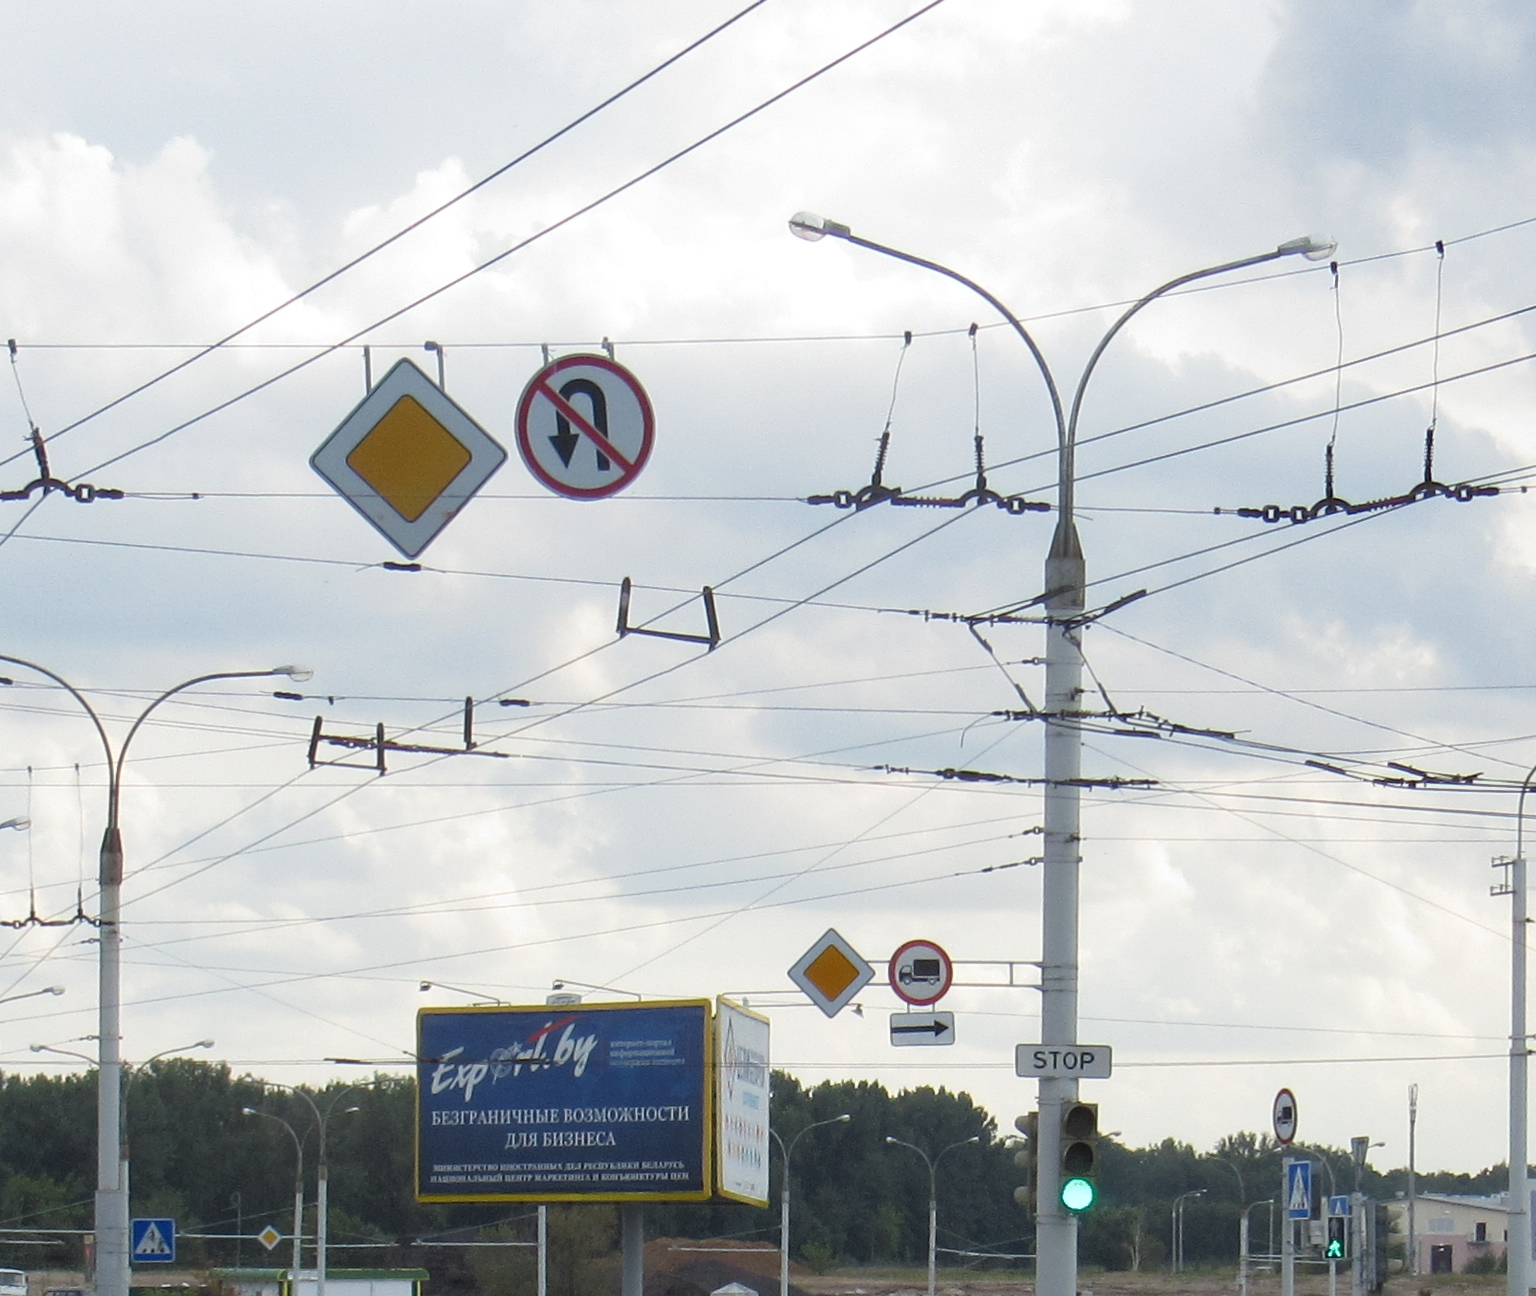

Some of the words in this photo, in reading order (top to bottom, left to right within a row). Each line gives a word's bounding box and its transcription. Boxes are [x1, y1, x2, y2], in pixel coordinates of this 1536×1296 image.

[1033, 1051, 1095, 1070] STOP
[431, 1109, 560, 1126] БЕЗГРАНИЧНЫЕ
[563, 1106, 690, 1123] ВОЗМОЖНОСТИ
[505, 1132, 539, 1150] ДЛЯ
[542, 1131, 617, 1148] БИЗНЕСА
